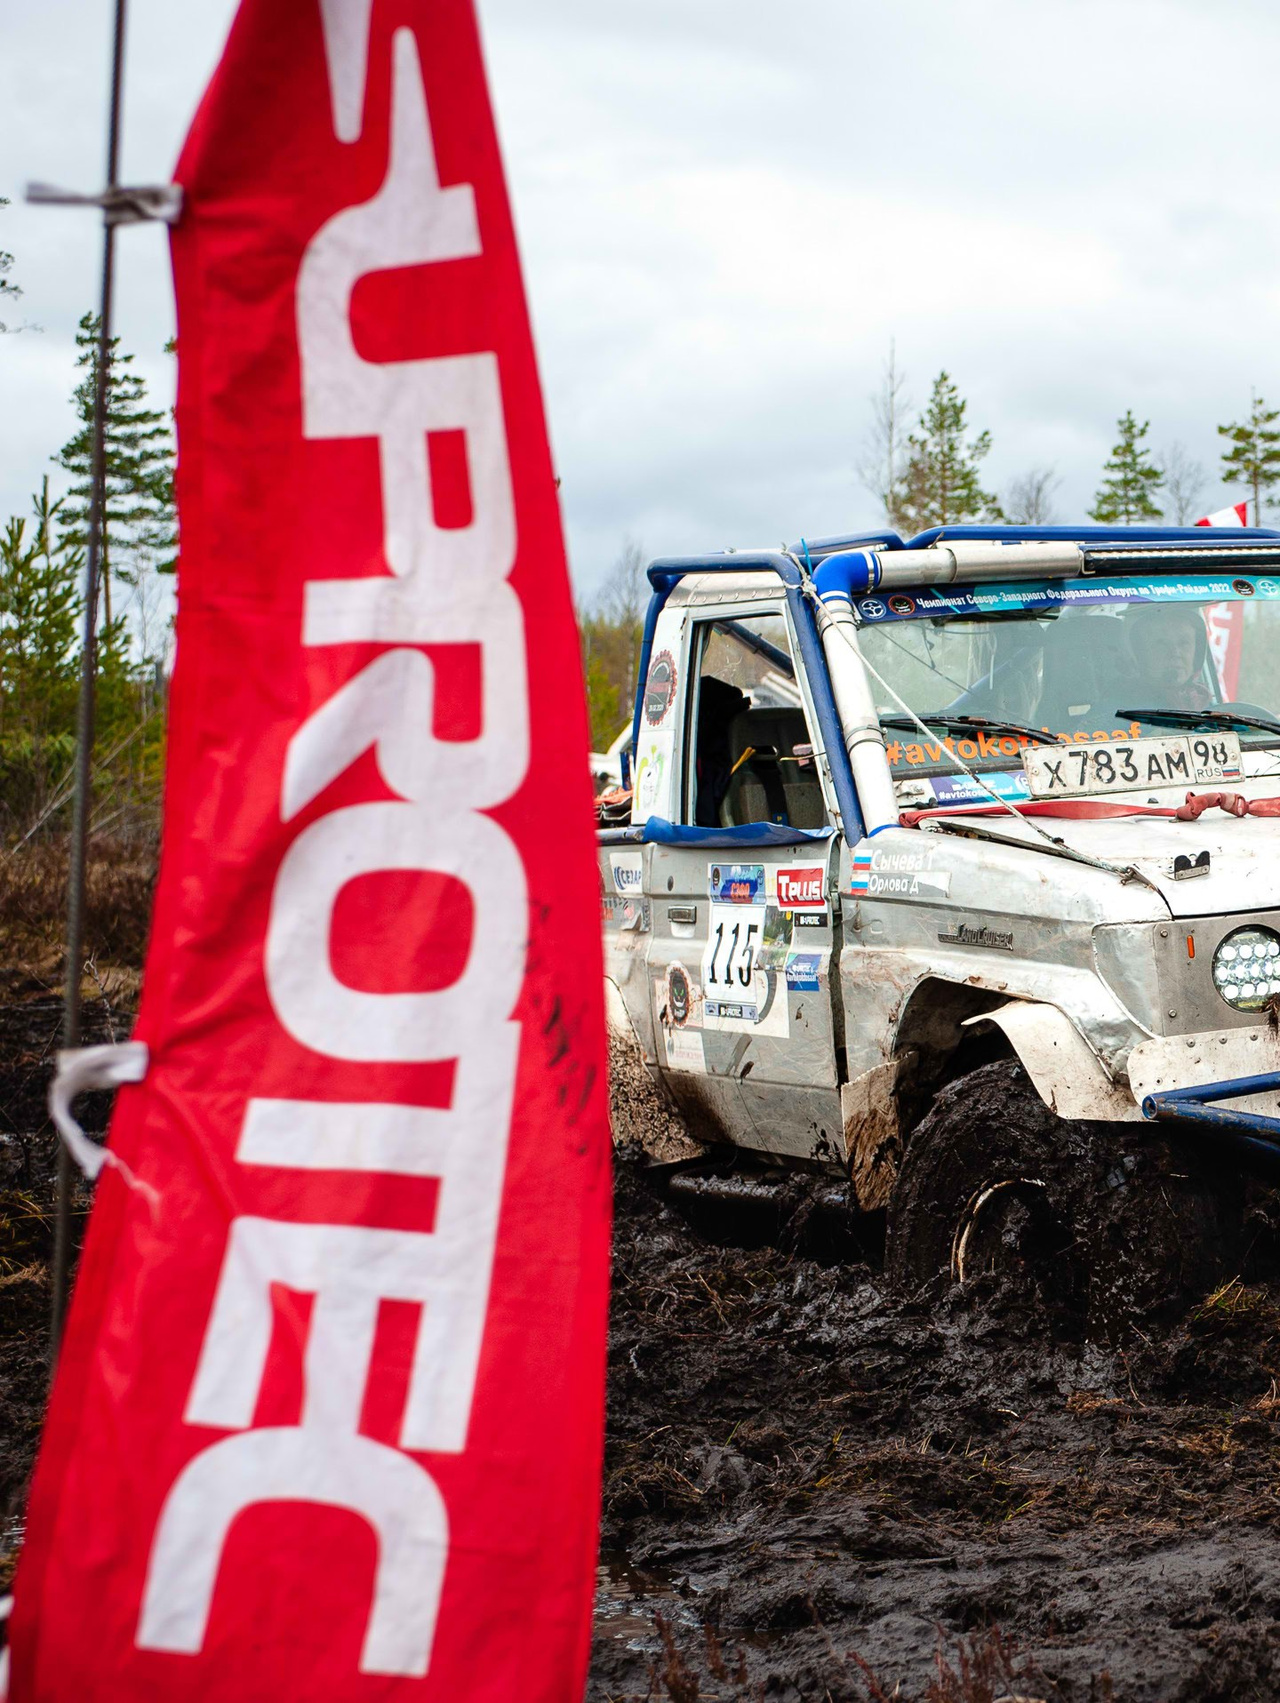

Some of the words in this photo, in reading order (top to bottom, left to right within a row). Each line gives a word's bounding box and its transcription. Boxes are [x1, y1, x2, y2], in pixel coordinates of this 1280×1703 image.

[916, 597, 966, 610] Чемпионат
[966, 591, 1046, 606] Северо-Западного
[1046, 586, 1109, 600] Федерального
[1109, 585, 1138, 598] Округа
[1138, 586, 1150, 595] по
[1210, 582, 1232, 594] 2022
[1194, 740, 1228, 766] 98
[1197, 768, 1222, 778] RUS
[871, 850, 924, 871] Сычева
[868, 874, 909, 894] Орлова
[909, 873, 920, 895] Д
[709, 922, 759, 987] 115
